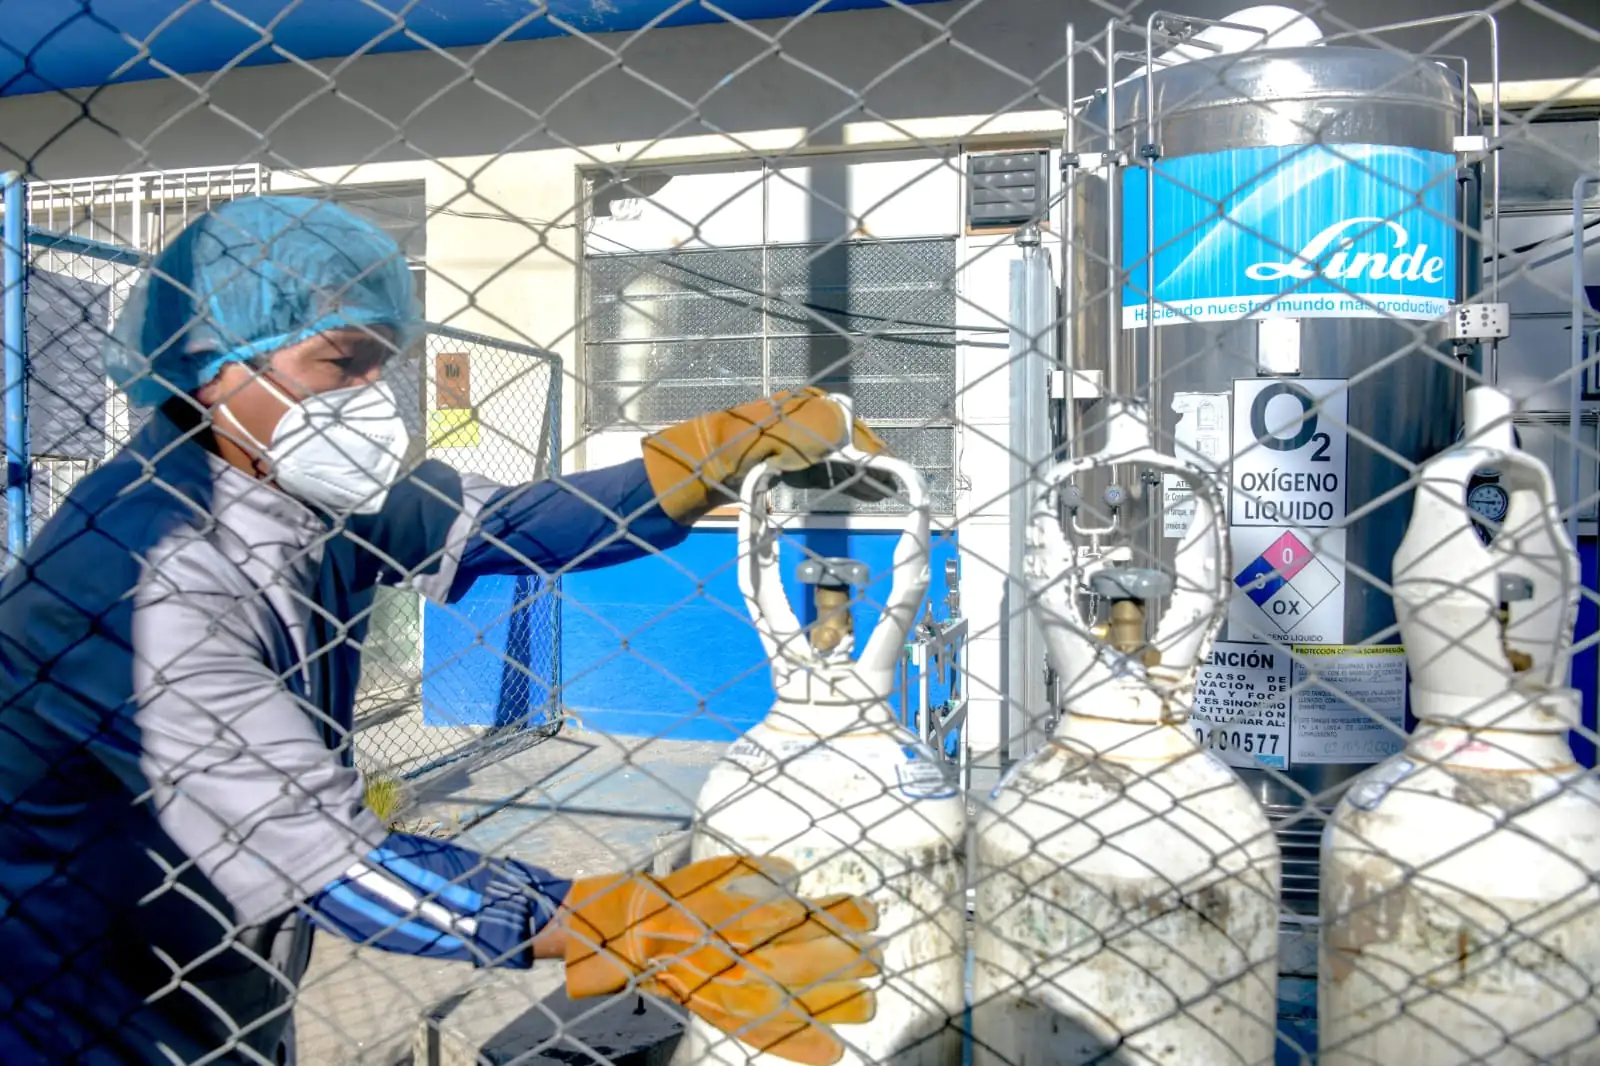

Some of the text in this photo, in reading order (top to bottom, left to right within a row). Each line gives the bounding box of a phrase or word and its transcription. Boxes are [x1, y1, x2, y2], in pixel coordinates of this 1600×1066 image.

[1245, 217, 1444, 283] Linde
[1135, 304, 1203, 321] Hciendo
[1208, 300, 1272, 315] nuestro
[1277, 298, 1335, 312] mundo
[1377, 299, 1445, 316] productivo
[1240, 468, 1338, 493] OXÍGENO
[1244, 497, 1334, 523] LÍQUIDO
[1282, 548, 1294, 565] 0
[1273, 600, 1300, 615] OX
[1204, 671, 1287, 683] CASO DE
[1248, 692, 1284, 700] FOC
[1266, 719, 1286, 727] AL:
